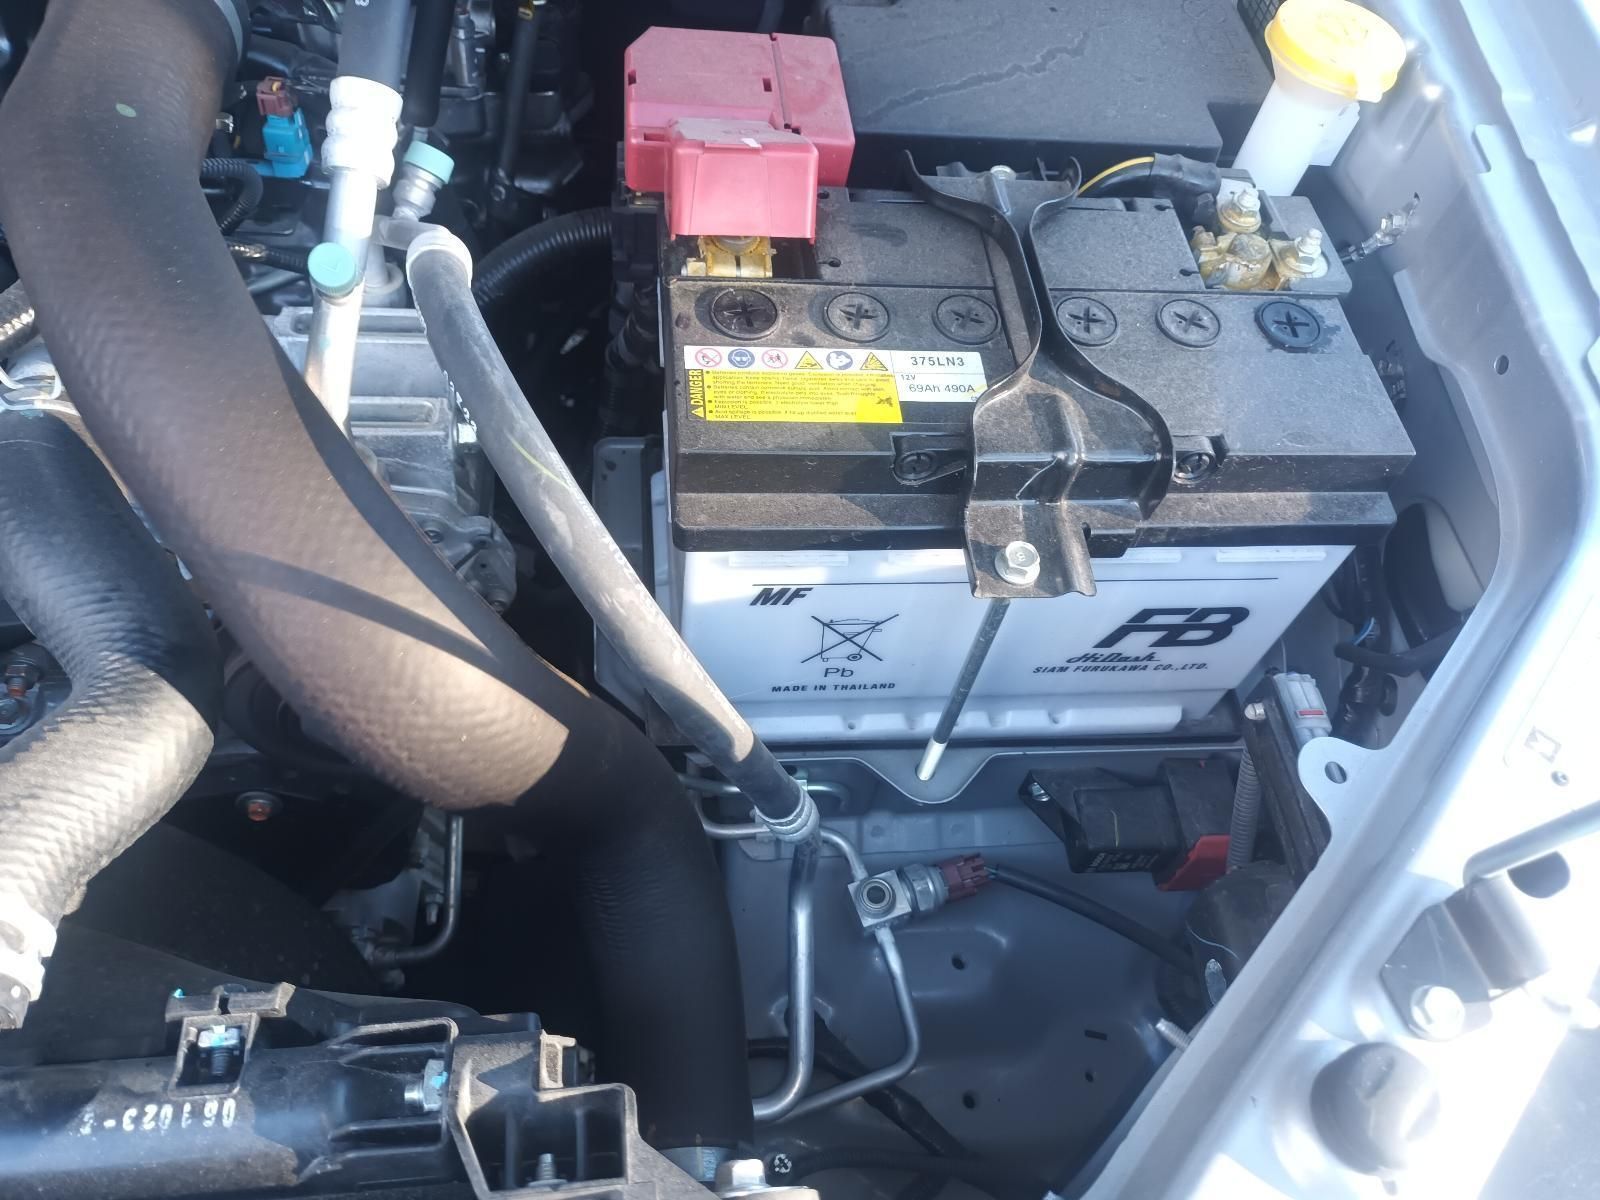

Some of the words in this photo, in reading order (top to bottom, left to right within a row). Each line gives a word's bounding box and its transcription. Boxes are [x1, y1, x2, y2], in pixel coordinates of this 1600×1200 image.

[910, 356, 965, 367] 375LN3
[688, 369, 704, 406] DANGER
[908, 384, 941, 393] 69Ah
[944, 384, 976, 393] 490A
[749, 587, 814, 606] MF
[1092, 606, 1250, 649] FB
[823, 667, 854, 678] Pb
[1032, 665, 1070, 674] SIAM
[1073, 664, 1149, 673] FURUKAWA
[771, 684, 809, 693] MADE
[813, 684, 827, 692] IN
[833, 682, 896, 691] THAILAND
